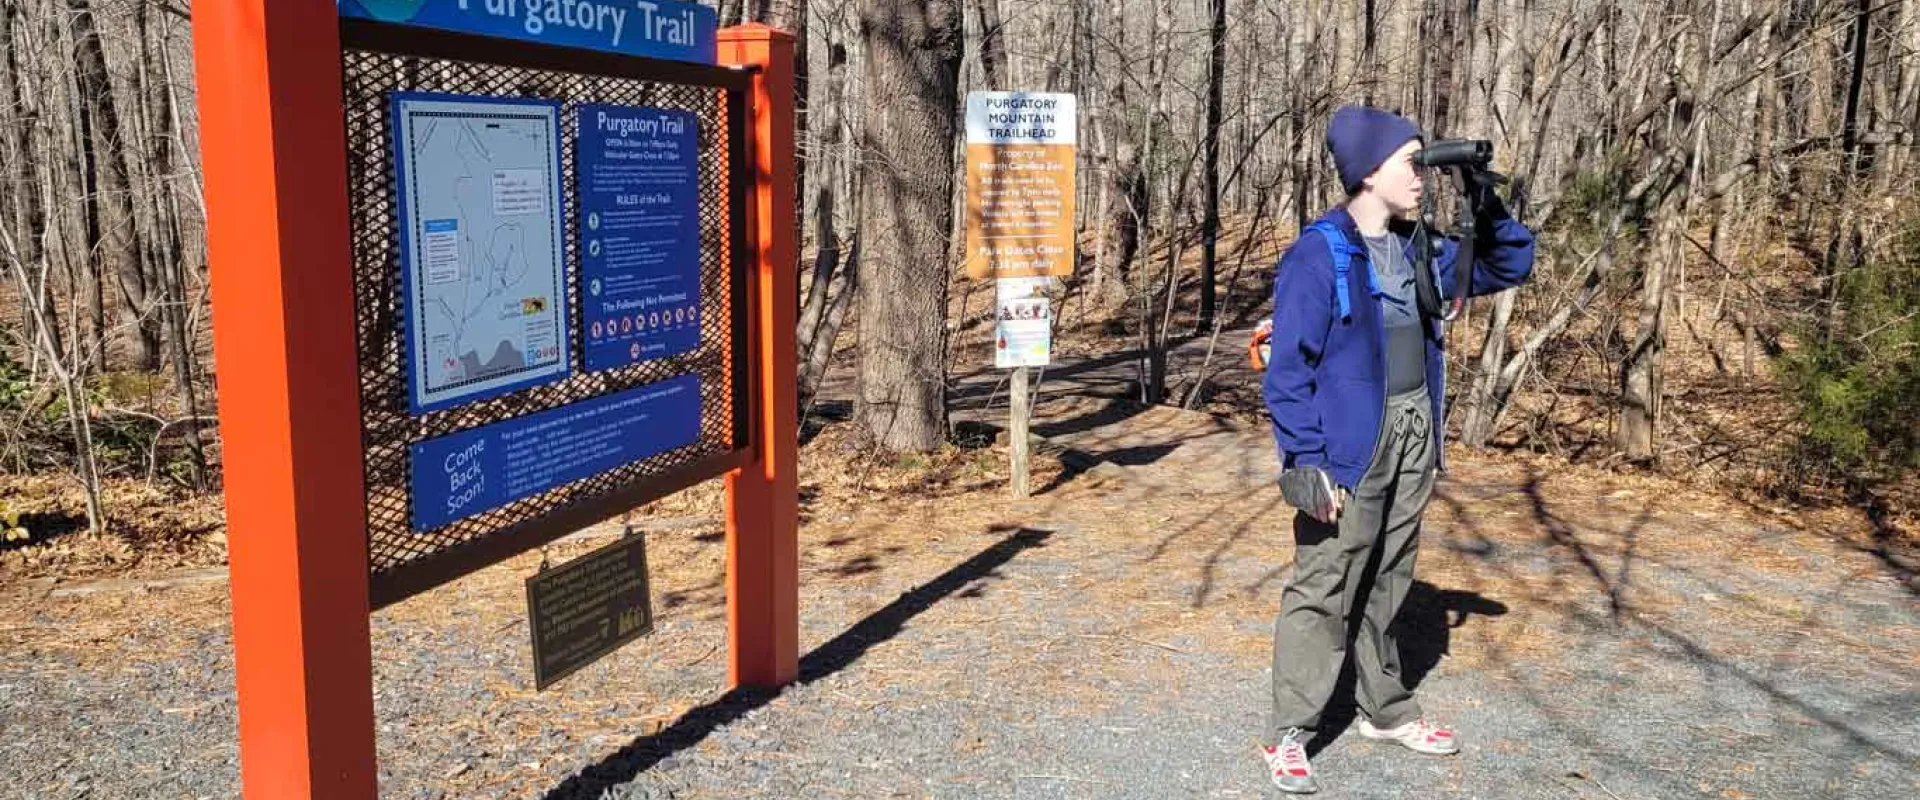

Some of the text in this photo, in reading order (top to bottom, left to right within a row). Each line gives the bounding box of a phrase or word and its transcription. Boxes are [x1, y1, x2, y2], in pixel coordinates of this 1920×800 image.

[637, 1, 695, 46] Trail
[986, 98, 1057, 109] PURGATORY
[597, 111, 684, 138] Purgatory Trail
[988, 113, 1055, 124] MOUNTAIN
[988, 128, 1056, 138] TRAILHEAD
[444, 439, 485, 473] Come
[450, 462, 482, 493] Back
[446, 478, 485, 515] Soon!
